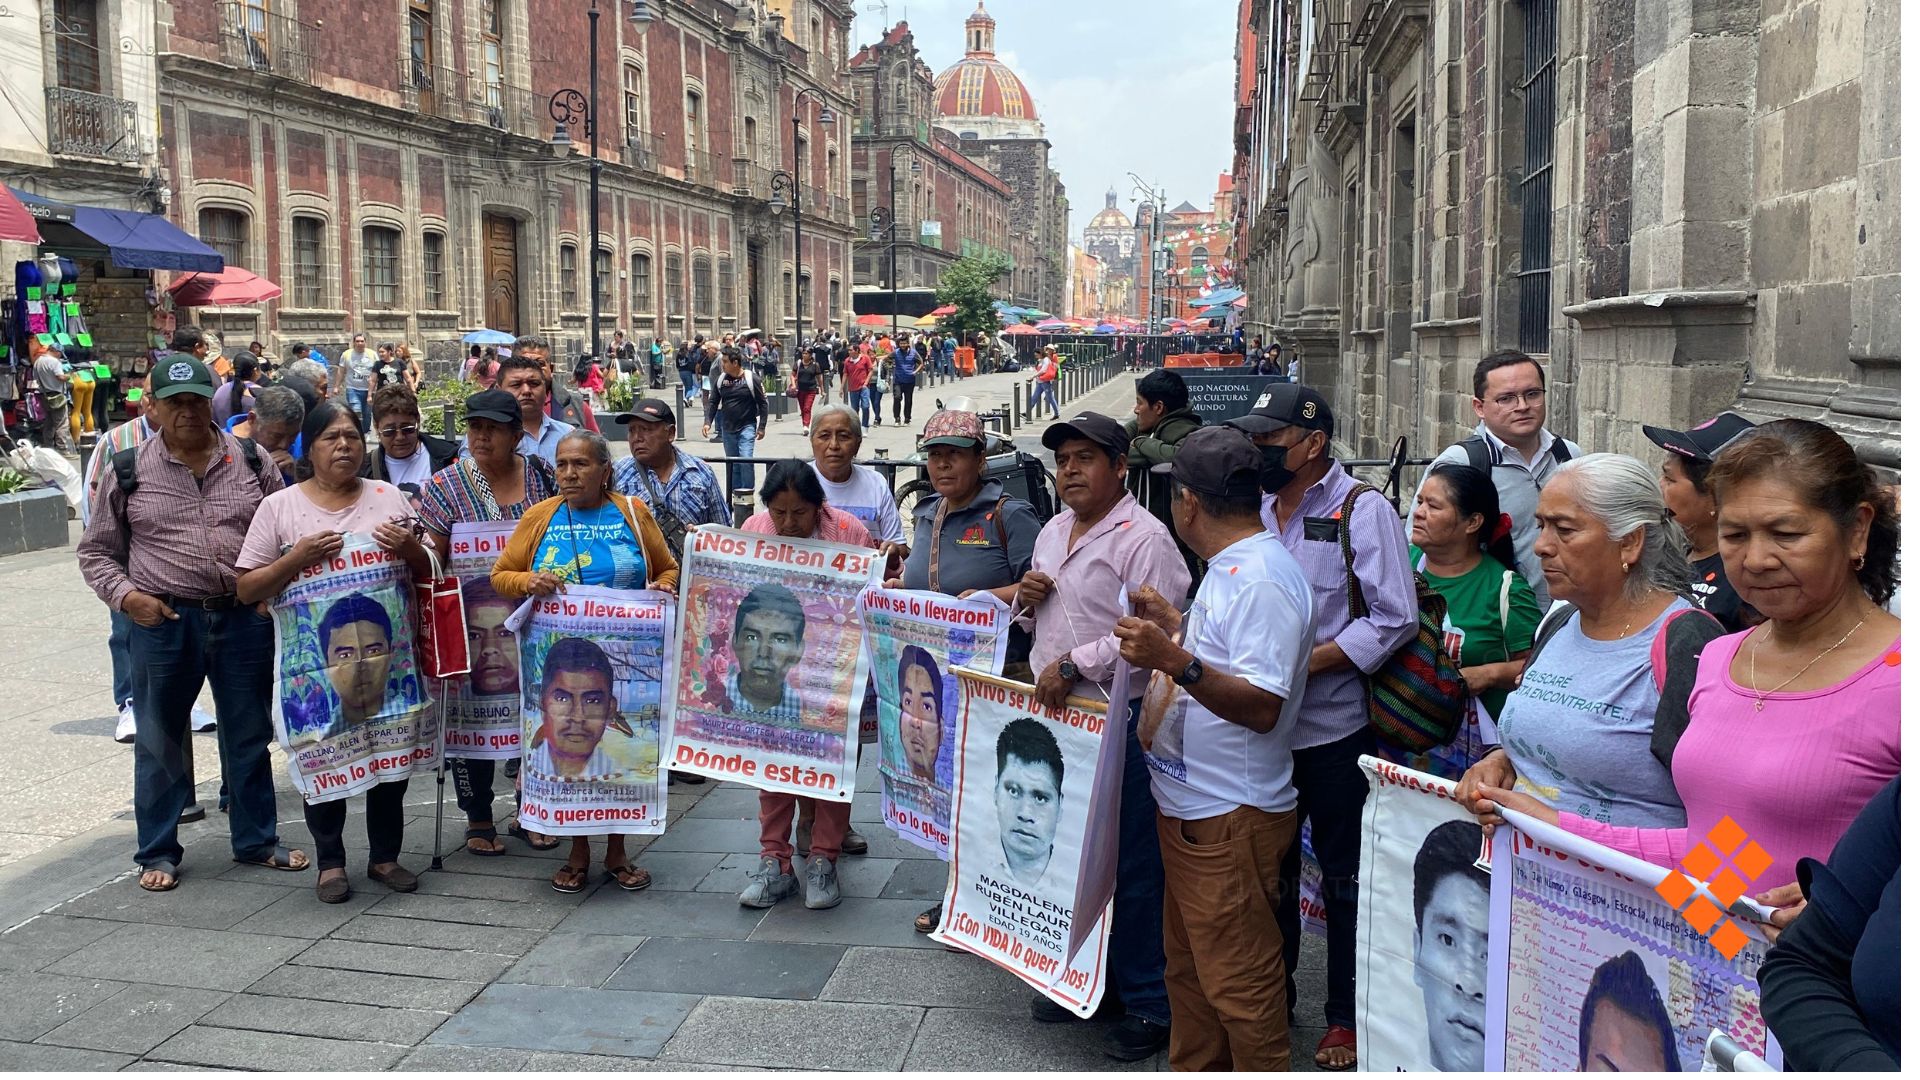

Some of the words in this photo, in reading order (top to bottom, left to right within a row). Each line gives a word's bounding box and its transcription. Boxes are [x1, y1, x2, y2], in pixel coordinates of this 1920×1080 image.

[1204, 393, 1248, 402] CULTURAS
[1206, 384, 1250, 392] NACIONAL
[1303, 401, 1317, 419] 3
[454, 541, 469, 554] se
[475, 537, 491, 552] lo
[694, 531, 747, 556] ¡Nos
[754, 540, 824, 568] faltan
[831, 553, 871, 575] 43!
[302, 563, 323, 579] se
[329, 556, 346, 572] lo
[543, 601, 559, 614] se
[563, 601, 578, 616] lo
[584, 601, 662, 619] llevaron!
[864, 590, 890, 612] ¡Vivo
[893, 599, 907, 614] se
[910, 598, 920, 616] lo
[925, 600, 995, 627] llevaron!
[1525, 669, 1572, 689] BUSCARÉ
[970, 679, 1005, 704] ¡Vivo
[1009, 691, 1025, 709] se
[473, 706, 510, 718] BRUNO
[397, 725, 409, 735] DE
[473, 732, 485, 747] lo
[745, 725, 775, 738] ORTEGA
[781, 732, 816, 744] VALERIO
[676, 744, 757, 776] Dónde
[764, 766, 836, 790] están
[313, 772, 348, 795] ¡Vivo
[349, 765, 366, 781] lo
[457, 767, 474, 797] STEPS
[538, 803, 548, 820] lo
[554, 805, 647, 825] queremos!
[910, 811, 919, 829] lo
[975, 883, 1023, 912] RUBÉN
[1027, 906, 1070, 931] LAUR
[1573, 886, 1611, 908] Glasgow,
[1614, 897, 1650, 923] Escocia,
[1652, 914, 1680, 935] quiero
[989, 902, 1062, 940] VILLEGAS
[954, 912, 979, 938] ¡Con
[982, 923, 1009, 953] VIDA
[1010, 936, 1023, 960] lo
[988, 914, 1015, 931] EDAD
[1019, 928, 1030, 938] 19
[1033, 934, 1063, 953] AÑOS
